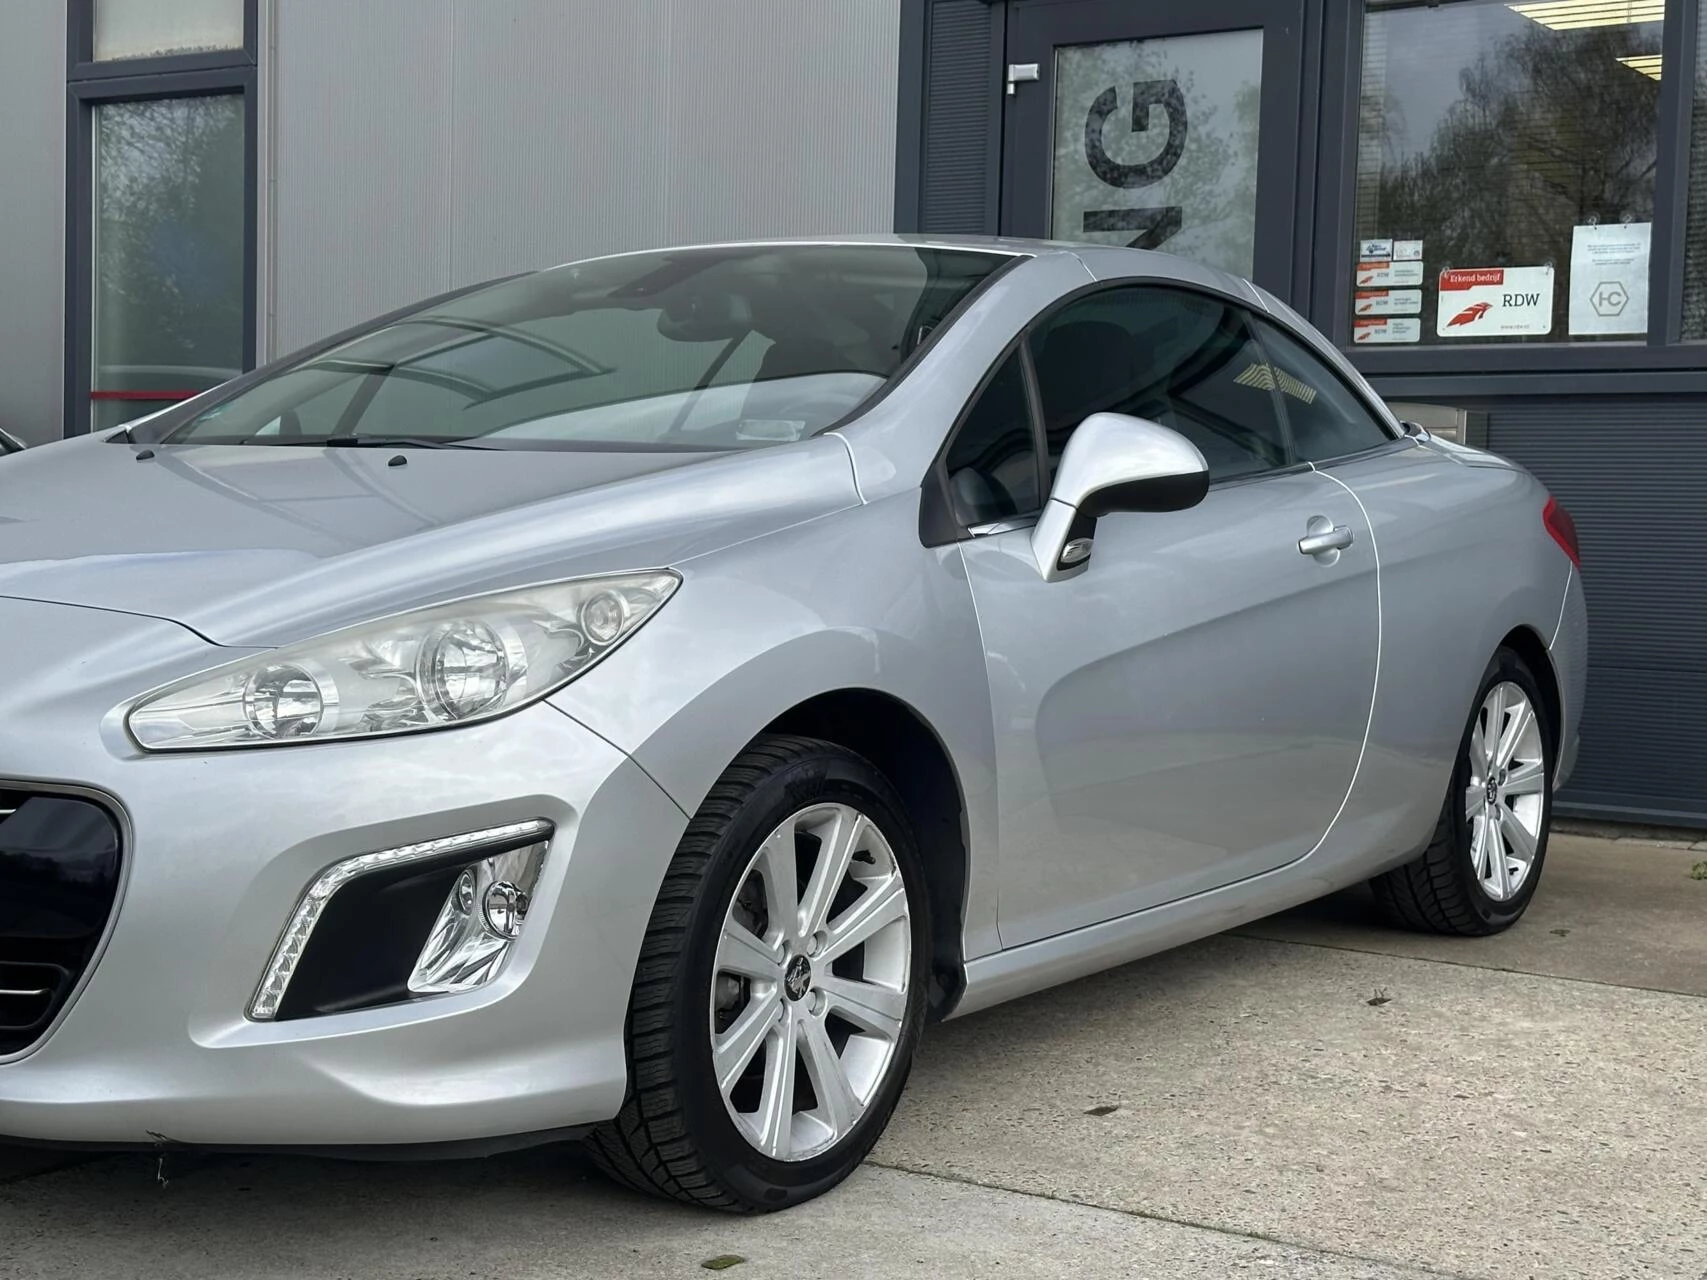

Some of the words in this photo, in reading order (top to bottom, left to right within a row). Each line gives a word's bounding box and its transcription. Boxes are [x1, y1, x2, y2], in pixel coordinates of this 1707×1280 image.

[1449, 274, 1476, 283] Erkend
[1476, 272, 1501, 283] bedrijf
[1502, 293, 1540, 307] RDW
